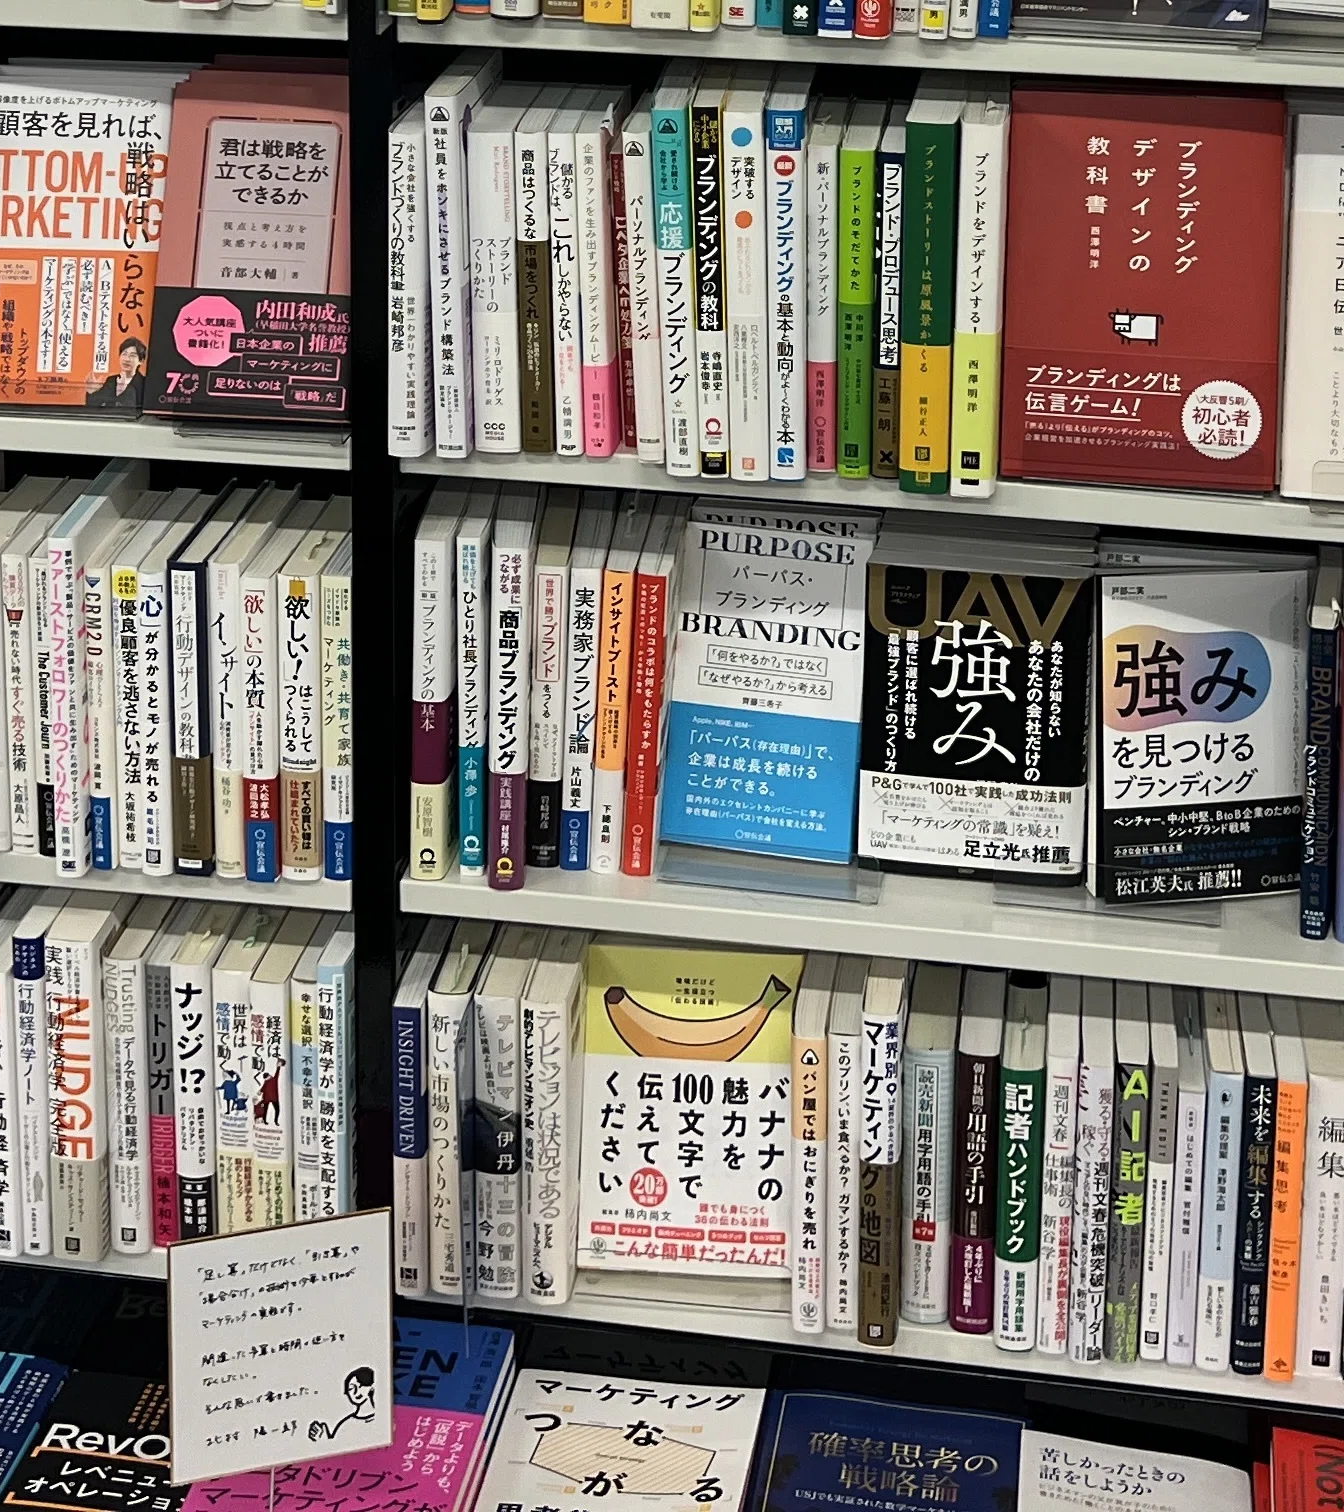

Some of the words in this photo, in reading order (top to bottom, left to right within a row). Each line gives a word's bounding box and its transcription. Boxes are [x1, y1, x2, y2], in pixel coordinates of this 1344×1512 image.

[214, 162, 329, 182] 立てることが
[219, 139, 328, 160] 君は戦略を
[1085, 136, 1110, 216] 教科書
[231, 185, 309, 206] できるか
[519, 150, 538, 240] 商品はつくるな
[1127, 137, 1158, 274] デザインの
[1172, 141, 1204, 276] ブランディング
[117, 141, 155, 335] 戦略はいらない
[1024, 392, 1143, 418] 伝言ゲーム!
[1025, 365, 1182, 393] ブランディングは
[1191, 407, 1250, 431] 初心者
[698, 529, 856, 566] PURPOSE
[605, 583, 624, 703] インサイトブースト
[680, 611, 861, 652] BRANDING
[118, 599, 143, 786] 優良顧客を逃さない方法
[929, 618, 1017, 766] 強み
[1113, 639, 1258, 719] 強み
[687, 753, 818, 779] 企業は成長を続ける
[1112, 733, 1255, 769] を見つける
[1113, 768, 1258, 800] ブランディング
[57, 995, 95, 1160] NUDGE
[175, 981, 206, 1095] ナッジ!?
[398, 1020, 414, 1081] INSIGHT
[398, 1093, 415, 1154] DRIVEN
[597, 1071, 624, 1194] ください
[635, 1073, 664, 1167] 伝えて
[671, 1073, 713, 1200] 100文字で
[721, 1075, 749, 1172] 魅力を
[755, 1077, 790, 1203] バナナの
[1003, 1083, 1036, 1254] 記者ハンドブック
[807, 1429, 1000, 1478] 確率思考の
[836, 1463, 961, 1505] 戦略論
[1037, 1446, 1186, 1485] 苦しかったときの
